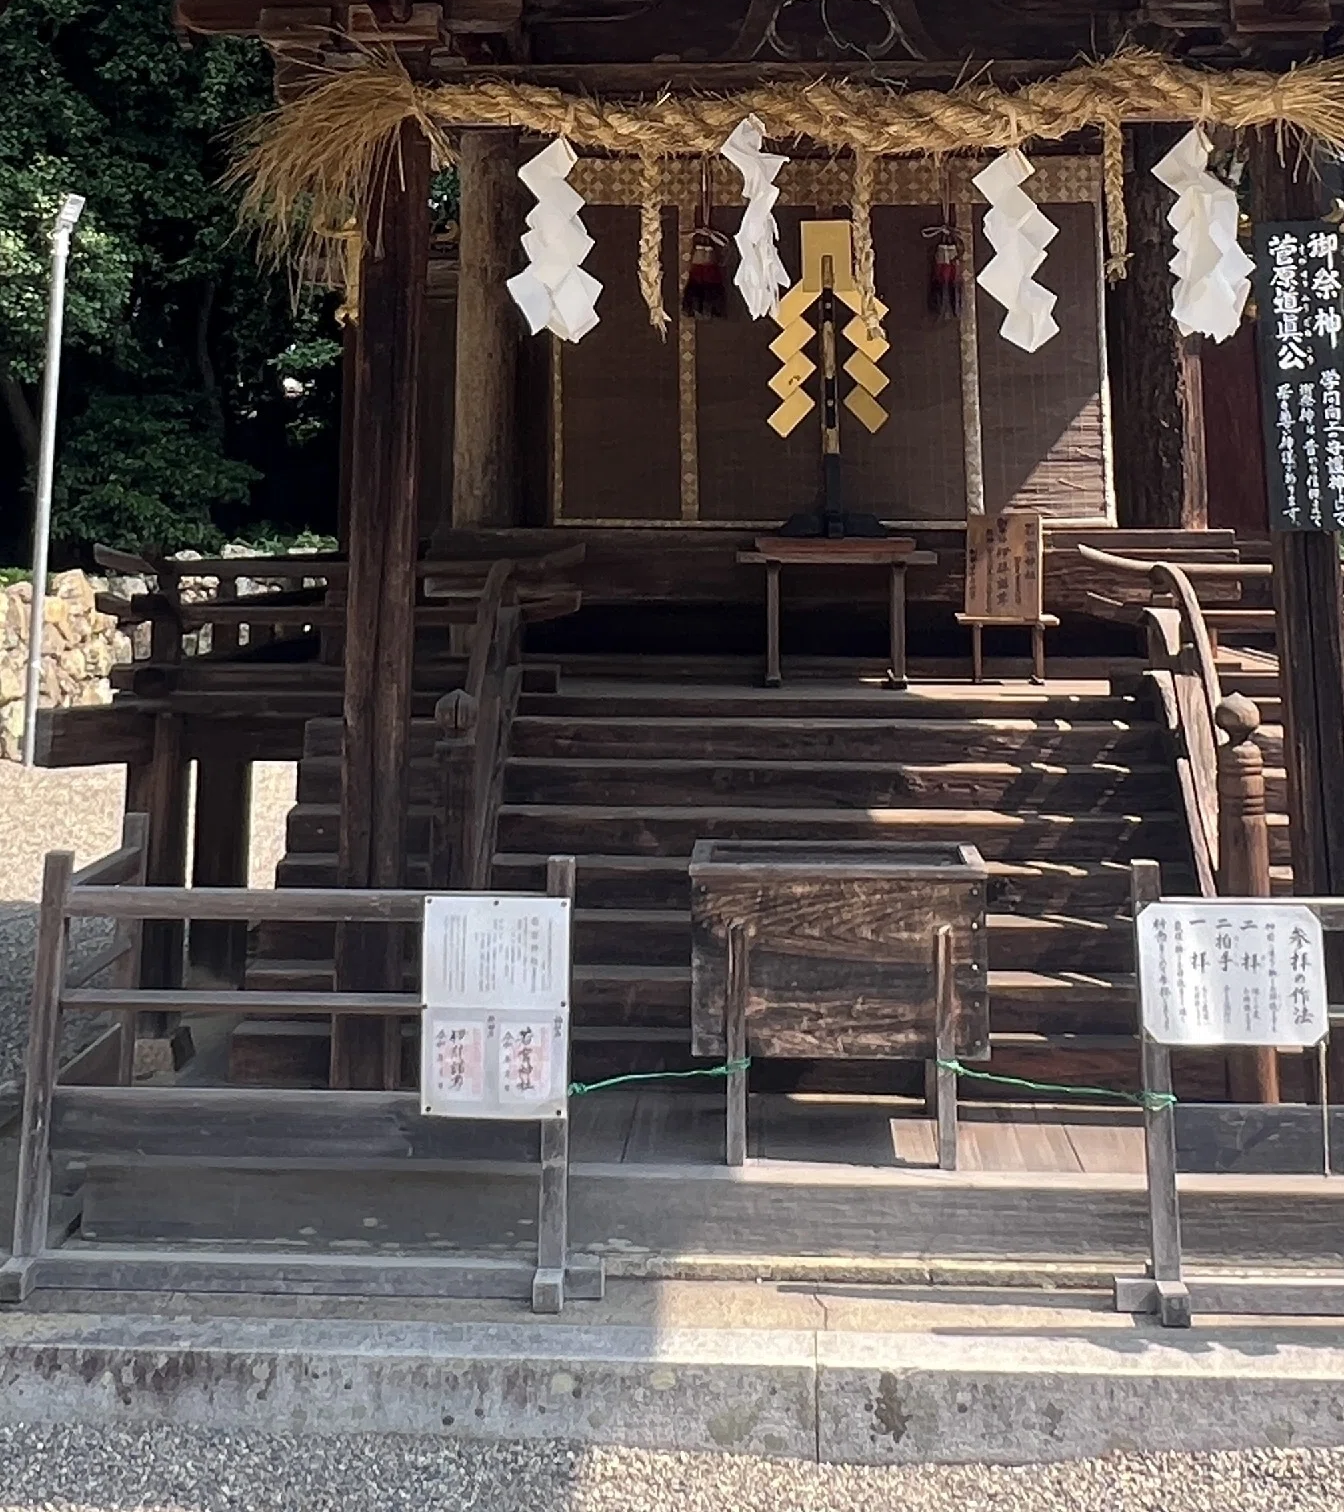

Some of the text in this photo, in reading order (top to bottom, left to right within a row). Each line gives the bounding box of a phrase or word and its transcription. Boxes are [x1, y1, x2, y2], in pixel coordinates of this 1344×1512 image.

[1307, 232, 1342, 349] 御祭神
[1288, 926, 1314, 1025] 参拝の作法
